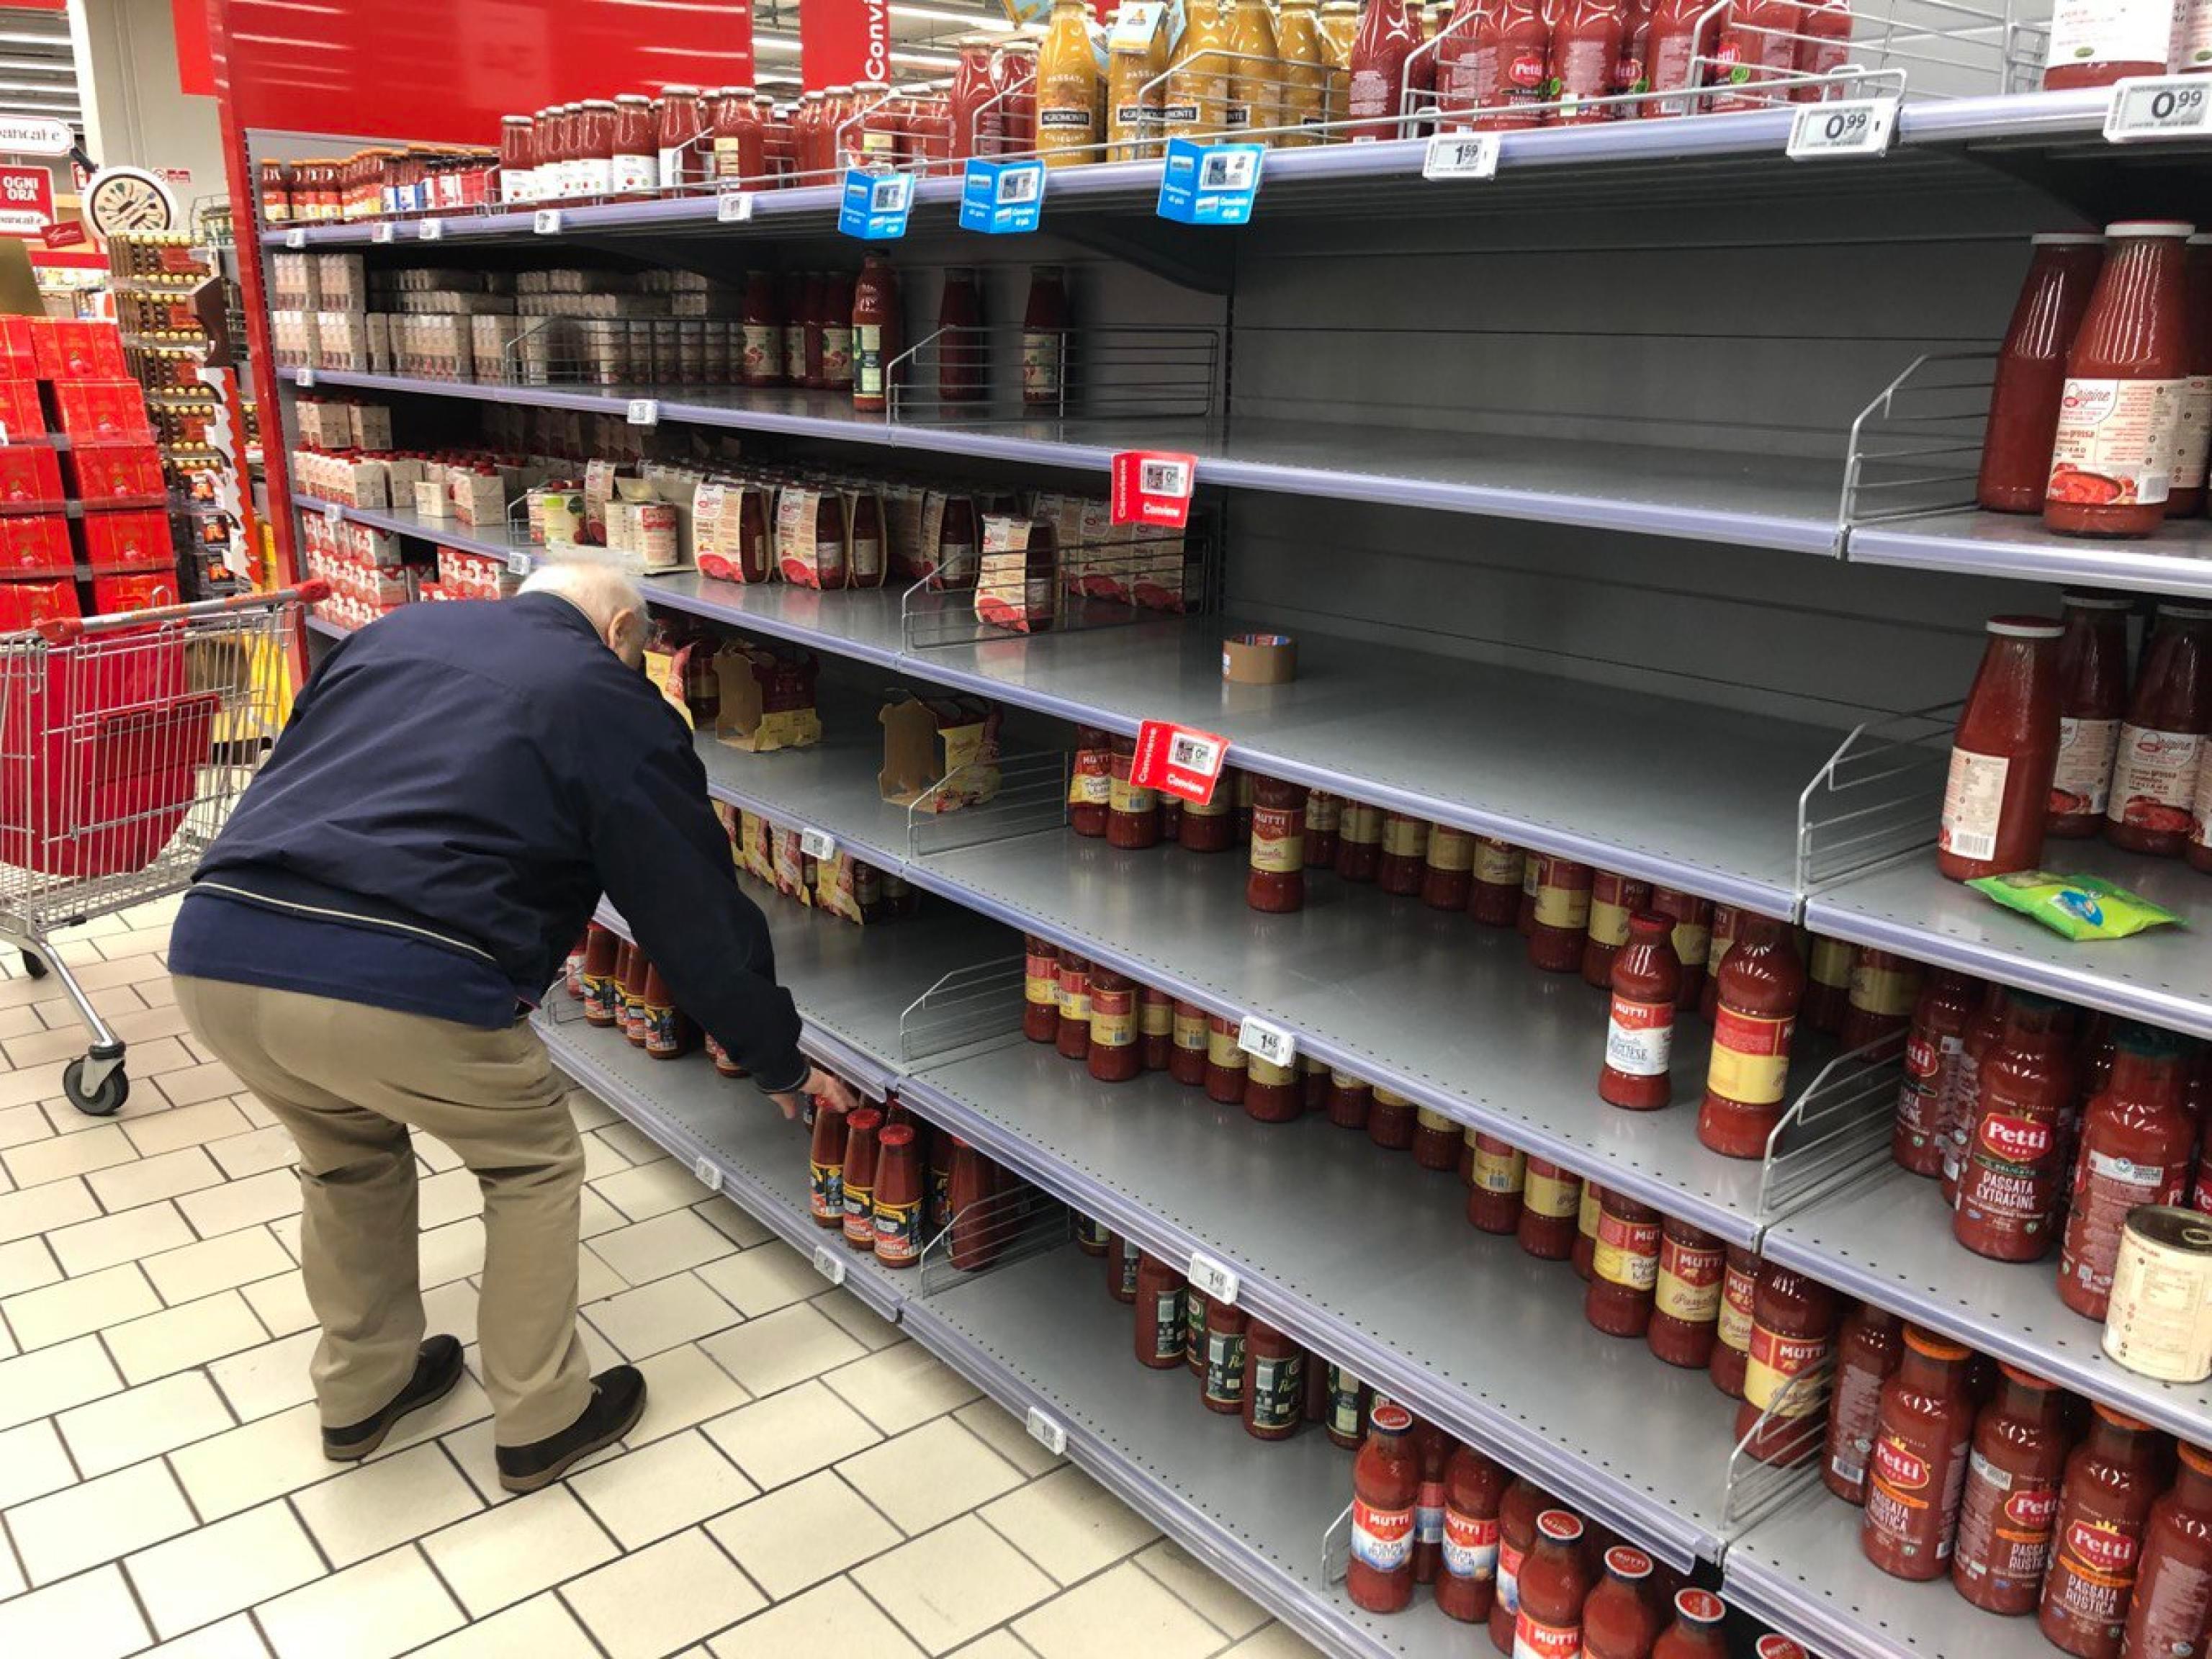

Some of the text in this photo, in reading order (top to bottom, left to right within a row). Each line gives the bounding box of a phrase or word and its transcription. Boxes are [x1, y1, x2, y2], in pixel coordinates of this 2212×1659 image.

[1255, 813, 1285, 825] MUTTI
[1614, 1002, 1647, 1019] MUTTI
[1987, 1120, 2047, 1150] Petti
[1982, 1169, 2034, 1195] PASSATA
[1876, 1442, 1920, 1480] Petti
[1370, 1513, 1409, 1527] MUTTI
[1445, 1512, 1481, 1536] MUTTI
[2074, 1528, 2132, 1560] Petti
[2068, 1573, 2118, 1603] PASSATA
[2065, 1586, 2116, 1617] RUSTICA
[1534, 1629, 1578, 1646] MUTTI
